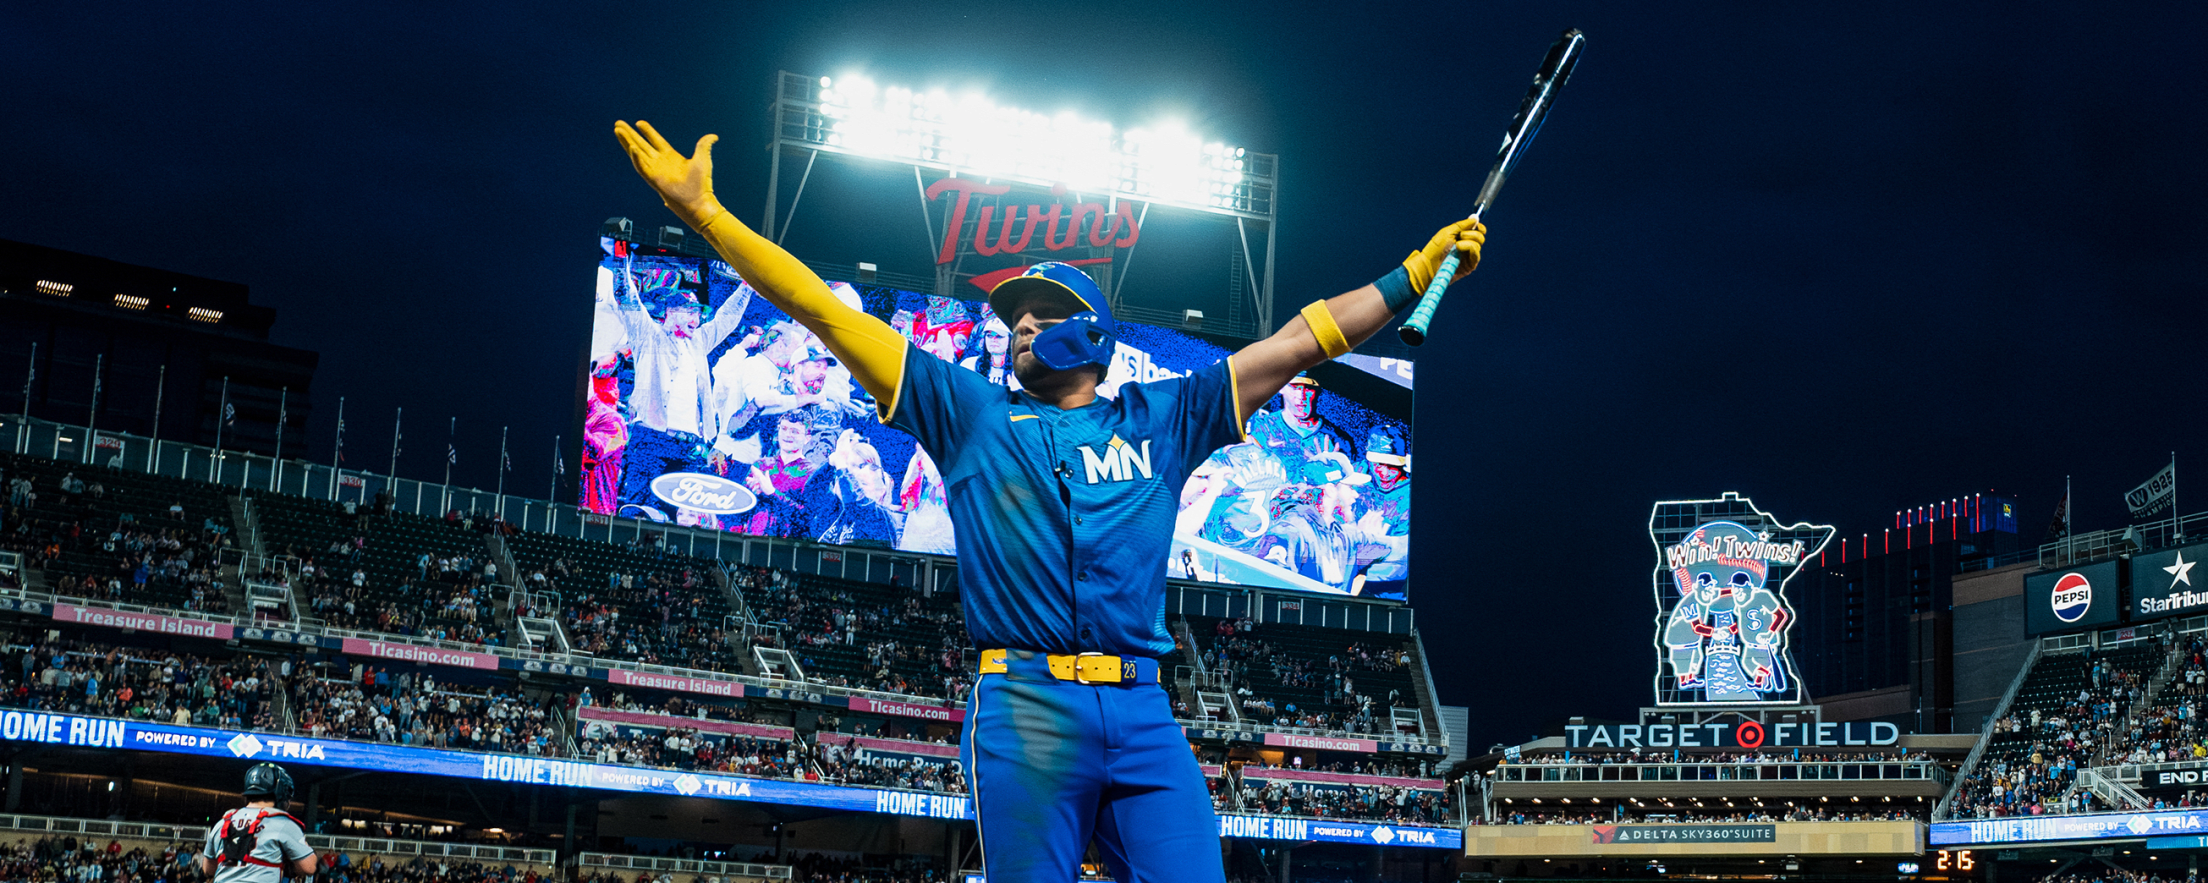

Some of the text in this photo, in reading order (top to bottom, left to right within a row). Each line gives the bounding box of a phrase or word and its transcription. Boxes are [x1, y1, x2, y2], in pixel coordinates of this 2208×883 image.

[926, 178, 1140, 265] Twins
[1077, 439, 1153, 484] MN
[672, 478, 737, 509] Ford
[2147, 470, 2173, 496] 1925
[1667, 535, 1802, 569] Win! Twins!
[2055, 590, 2088, 605] PEPSI
[2140, 590, 2208, 614] StarTribu
[74, 608, 215, 637] Treasure Island
[624, 672, 731, 695] Treasure Island
[1124, 663, 1136, 678] 23
[0, 710, 325, 760] OME RUN POWERED BY TRIA
[1565, 722, 1899, 747] TARGET FIELD
[483, 755, 751, 797] HOME RUN POWERED BY TRIA
[2159, 771, 2199, 784] END
[876, 790, 965, 819] HOME RUN
[1221, 815, 1435, 843] HOME RUN POWERED BY TRIA
[1634, 830, 1677, 839] DELTA
[1971, 815, 2201, 843] HOME RUN POWERED BY TRIA
